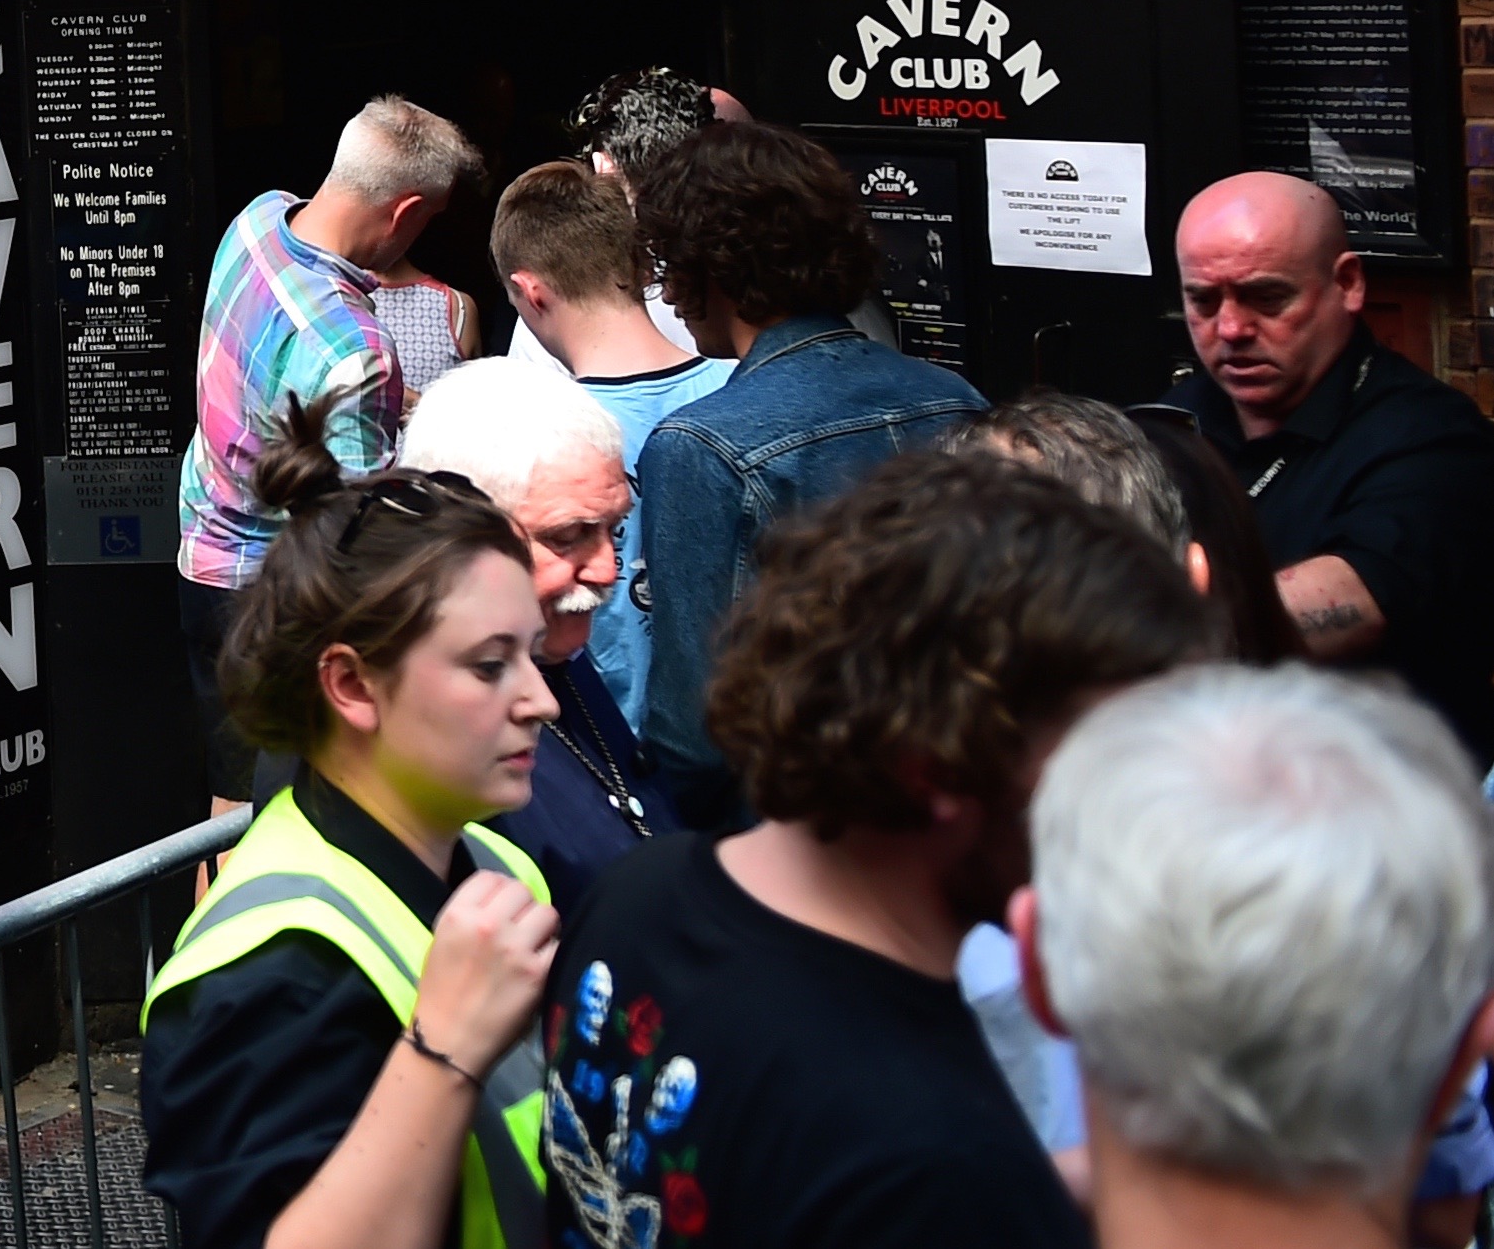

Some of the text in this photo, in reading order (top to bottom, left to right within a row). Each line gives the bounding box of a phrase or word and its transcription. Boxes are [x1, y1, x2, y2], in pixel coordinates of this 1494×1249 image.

[51, 13, 147, 26] CAVERN CLUB
[61, 26, 134, 37] OPENING TIMES
[889, 56, 991, 90] CLUB
[878, 97, 1008, 121] LIVERPOOL
[54, 132, 85, 140] CAVERN
[114, 130, 122, 138] IS
[126, 129, 157, 137] CLOSED
[72, 140, 118, 149] CHRISTMAS
[62, 162, 154, 179] Polite Notice
[860, 166, 919, 197] CAVERN
[875, 182, 902, 192] CLUB
[53, 190, 167, 208] We Welcome Families
[1001, 190, 1025, 199] THERE
[1037, 192, 1048, 200] NO
[1050, 193, 1080, 201] ACCESS
[1082, 194, 1109, 203] TODAY
[1111, 195, 1128, 204] FOR
[1008, 202, 1054, 212] CUSTOMERS
[1056, 204, 1090, 214] WISHING
[1092, 206, 1103, 214] TO
[85, 209, 136, 227] Until 8pm
[1047, 216, 1081, 225] THE LIFT
[1019, 228, 1112, 241] WE APOLOGISE FOR ANY
[60, 244, 164, 261] No Minors Under 18
[1035, 241, 1099, 252] INCONVENIENCE
[70, 262, 156, 279] on The Premises
[88, 280, 140, 299] After 8pm
[84, 326, 145, 336] DOOR CHARGE
[68, 343, 87, 351] FREE
[61, 459, 180, 472] FOR ASSISTANCE
[73, 472, 167, 484] PLEASE CALL
[1246, 456, 1287, 498] SECURITY
[76, 486, 104, 496] 0151
[109, 485, 132, 495] 236
[80, 496, 165, 509] THANK YOU
